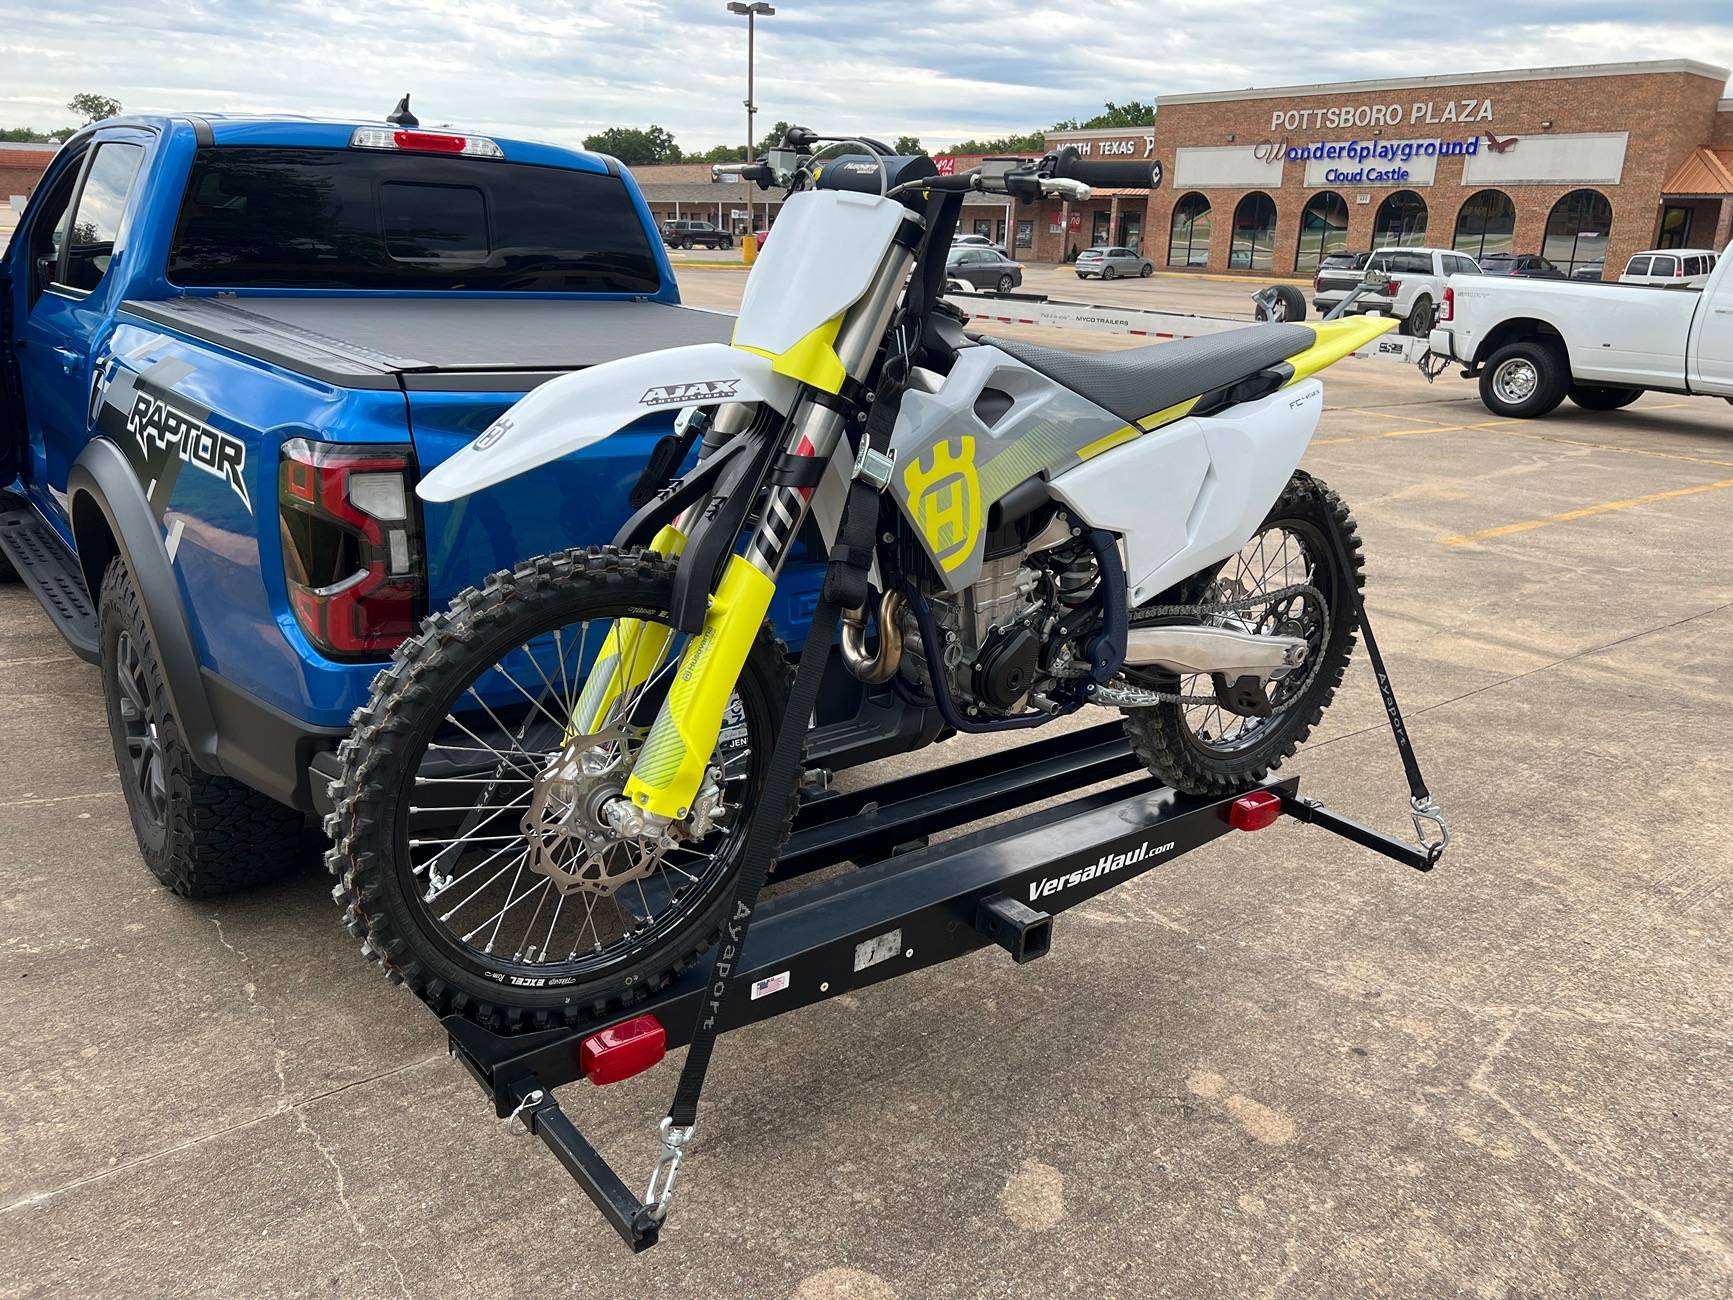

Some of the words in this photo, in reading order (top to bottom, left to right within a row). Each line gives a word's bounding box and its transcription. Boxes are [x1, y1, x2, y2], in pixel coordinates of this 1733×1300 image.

[1271, 103, 1403, 131] POTTSBORO
[1410, 99, 1494, 124] PLAZA
[1098, 140, 1135, 155] TEXAS
[1325, 168, 1363, 183] Cloud
[1366, 166, 1409, 182] Castle
[1075, 315, 1097, 323] MYCO
[1096, 318, 1129, 326] TRAILERS
[640, 379, 741, 402] AJAX
[126, 389, 253, 516] RAPTOR
[689, 625, 713, 672] Husqvarna
[1377, 672, 1408, 746] Ayaport
[1029, 841, 1175, 902] VersaHaul.com
[509, 975, 546, 987] EXCEL
[703, 900, 752, 1030] Ayaport
